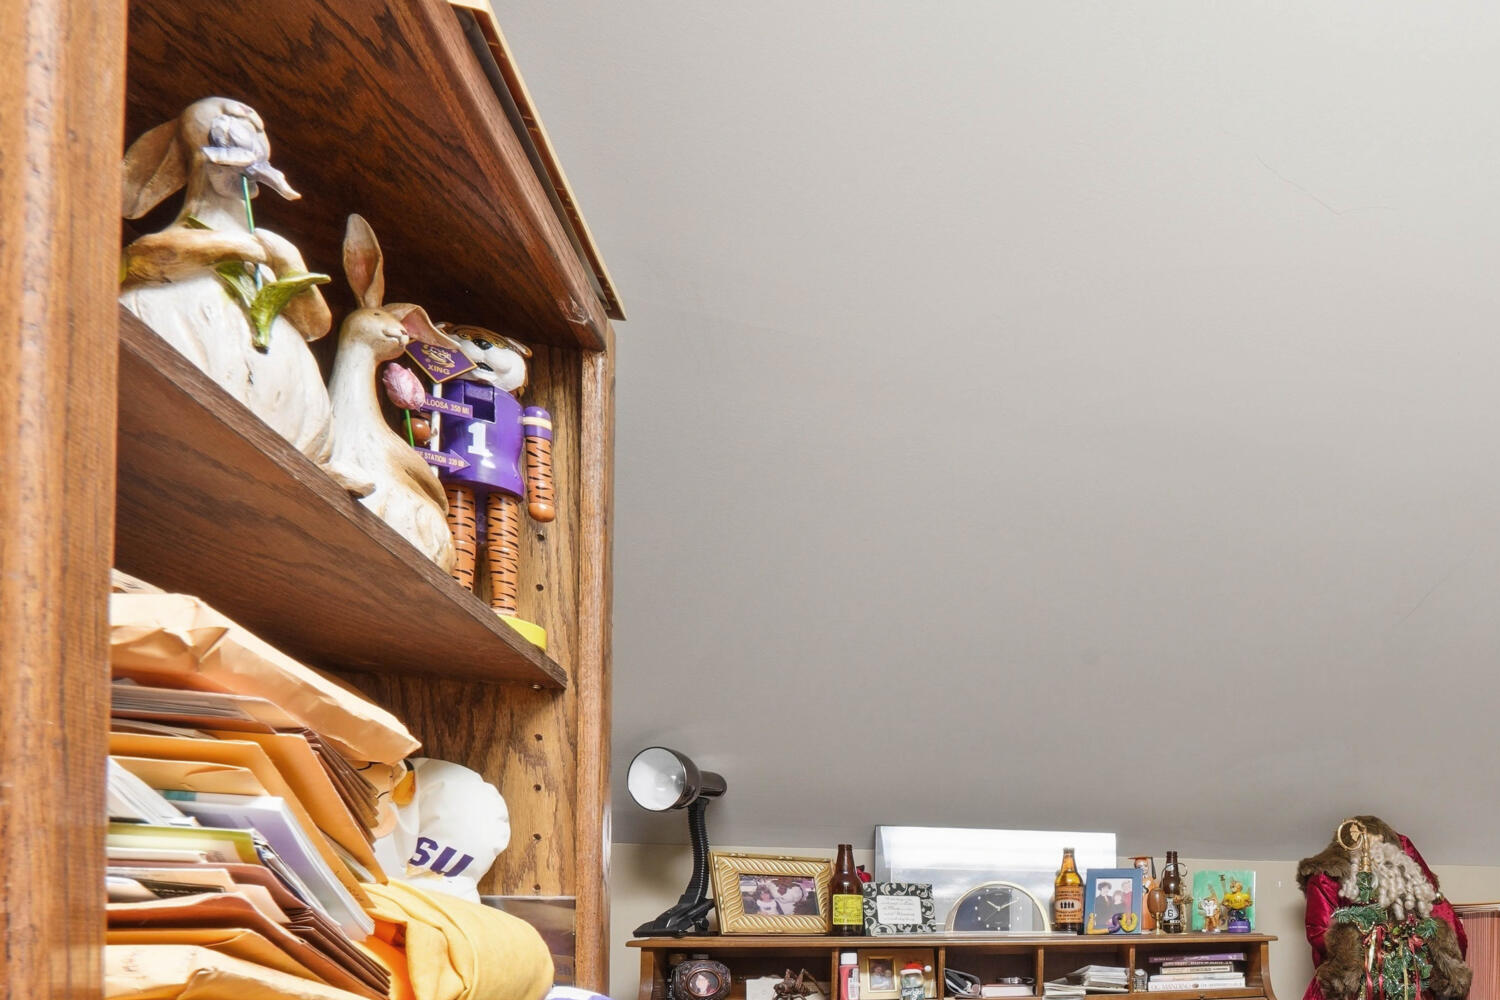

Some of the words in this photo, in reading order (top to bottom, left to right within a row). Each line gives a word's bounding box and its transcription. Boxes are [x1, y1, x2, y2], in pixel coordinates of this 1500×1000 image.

[427, 364, 451, 376] XING
[467, 421, 494, 457] 1
[424, 452, 447, 465] STATION
[1167, 909, 1174, 918] 6
[1086, 912, 1139, 935] LSU
